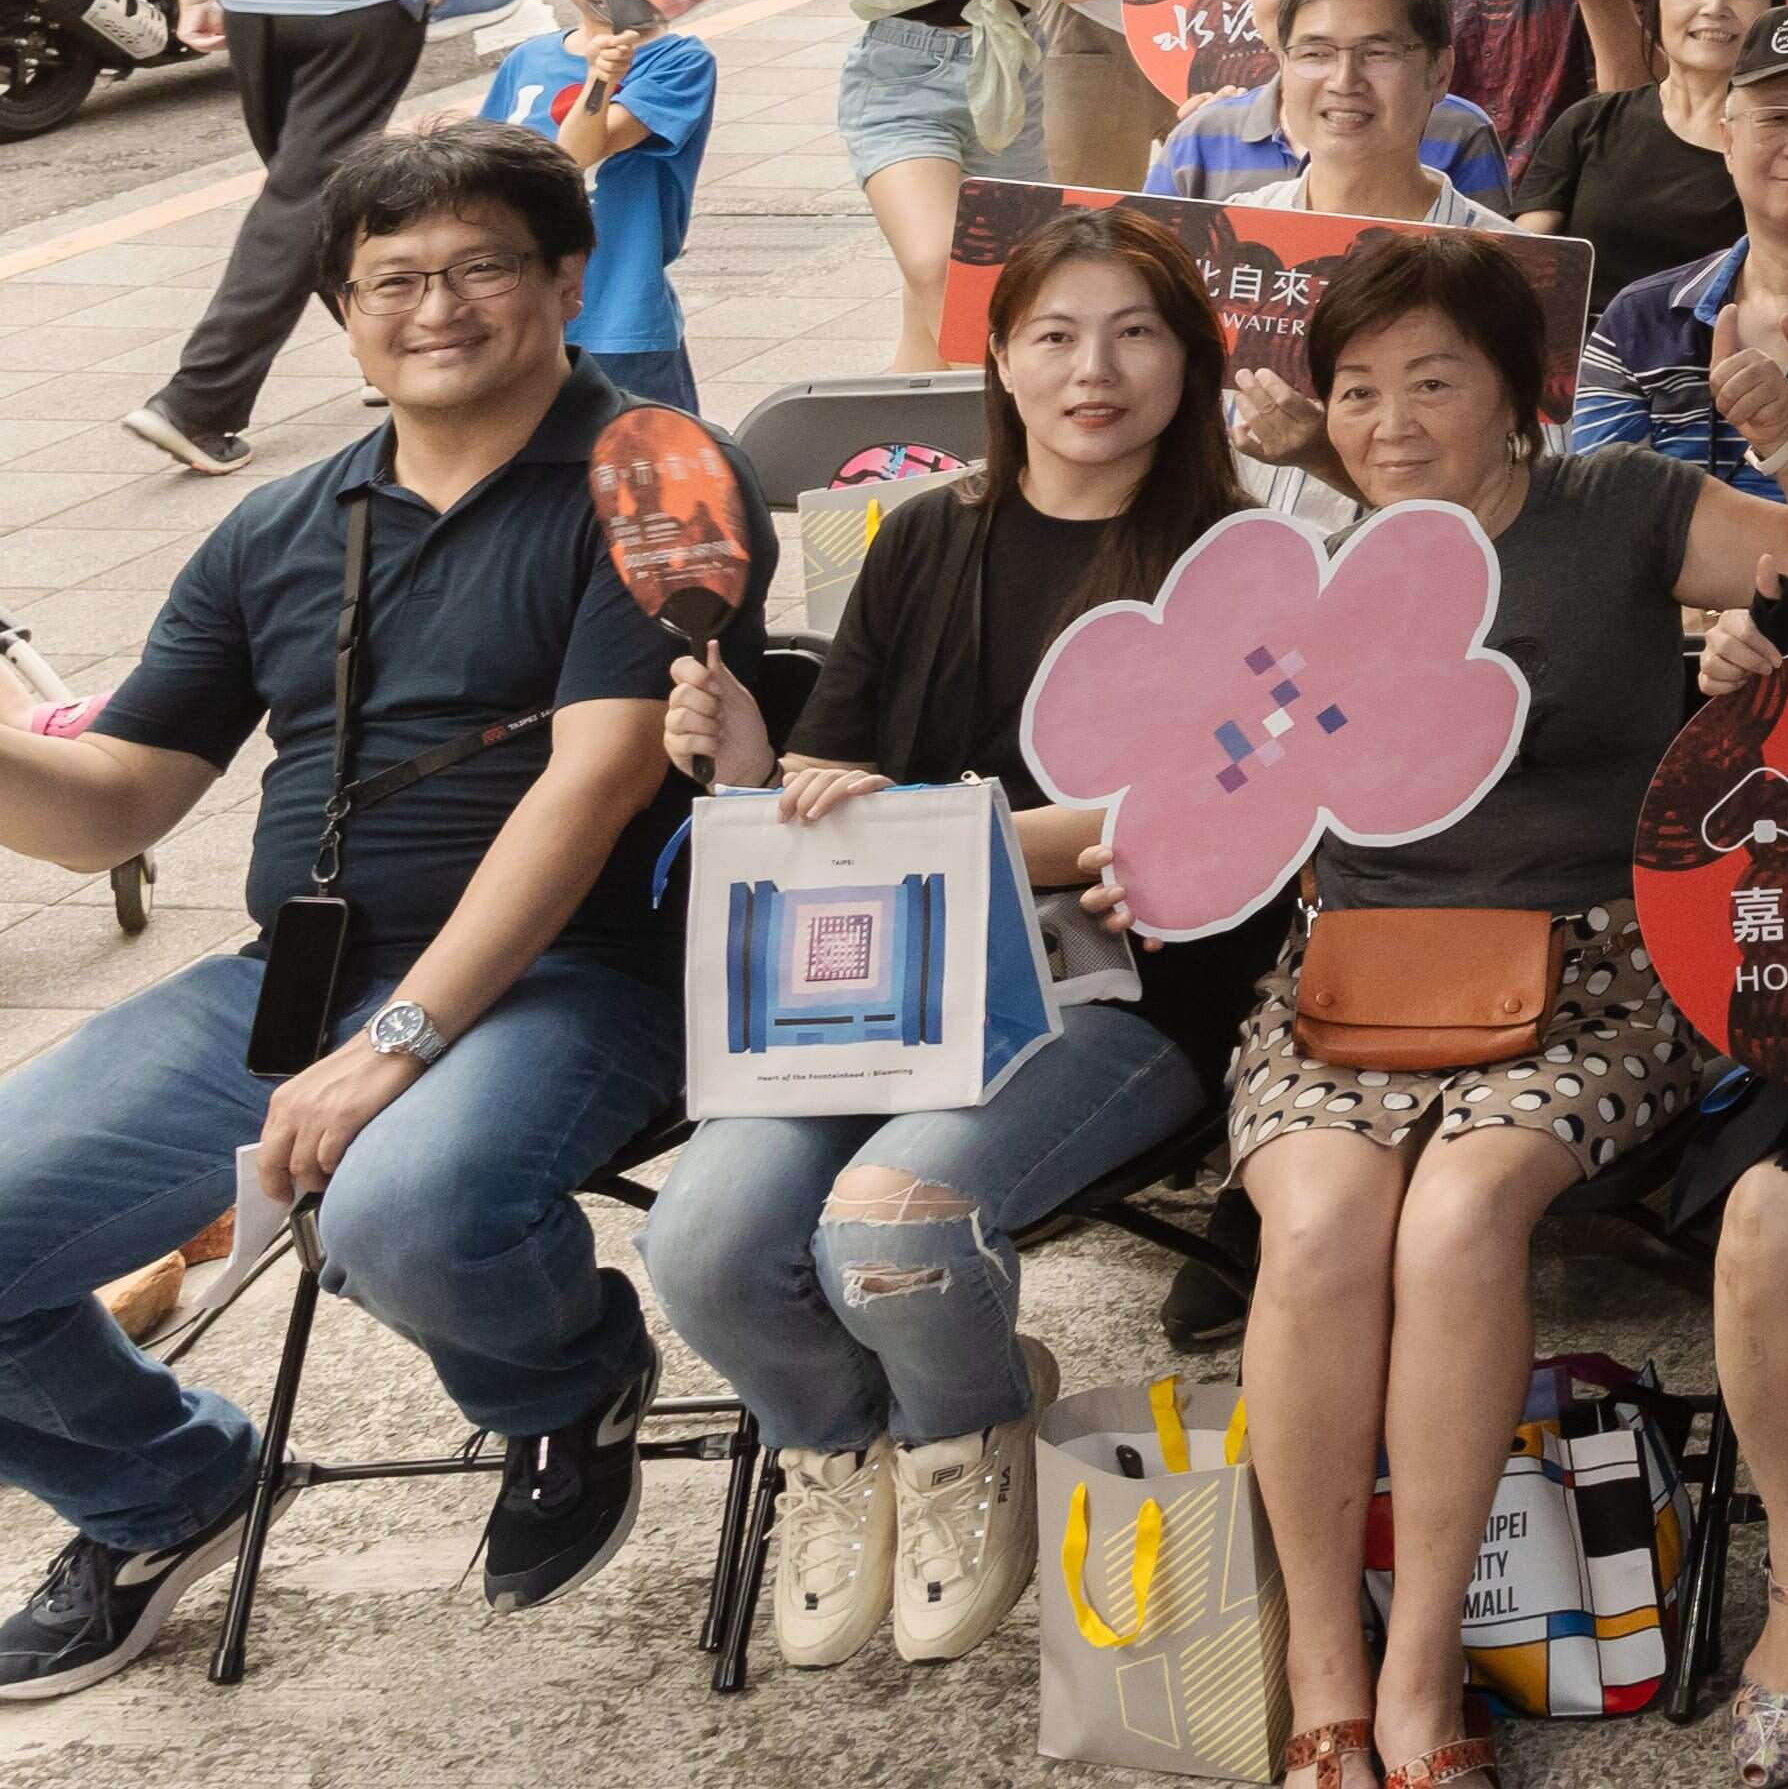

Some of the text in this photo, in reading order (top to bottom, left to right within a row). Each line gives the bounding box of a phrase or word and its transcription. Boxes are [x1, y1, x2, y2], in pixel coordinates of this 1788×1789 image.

[1196, 259, 1327, 307] 北自來
[1222, 312, 1306, 336] WATER
[997, 1466, 1011, 1505] FILA
[1484, 1511, 1528, 1544] IPEI
[1463, 1586, 1520, 1620] MALL
